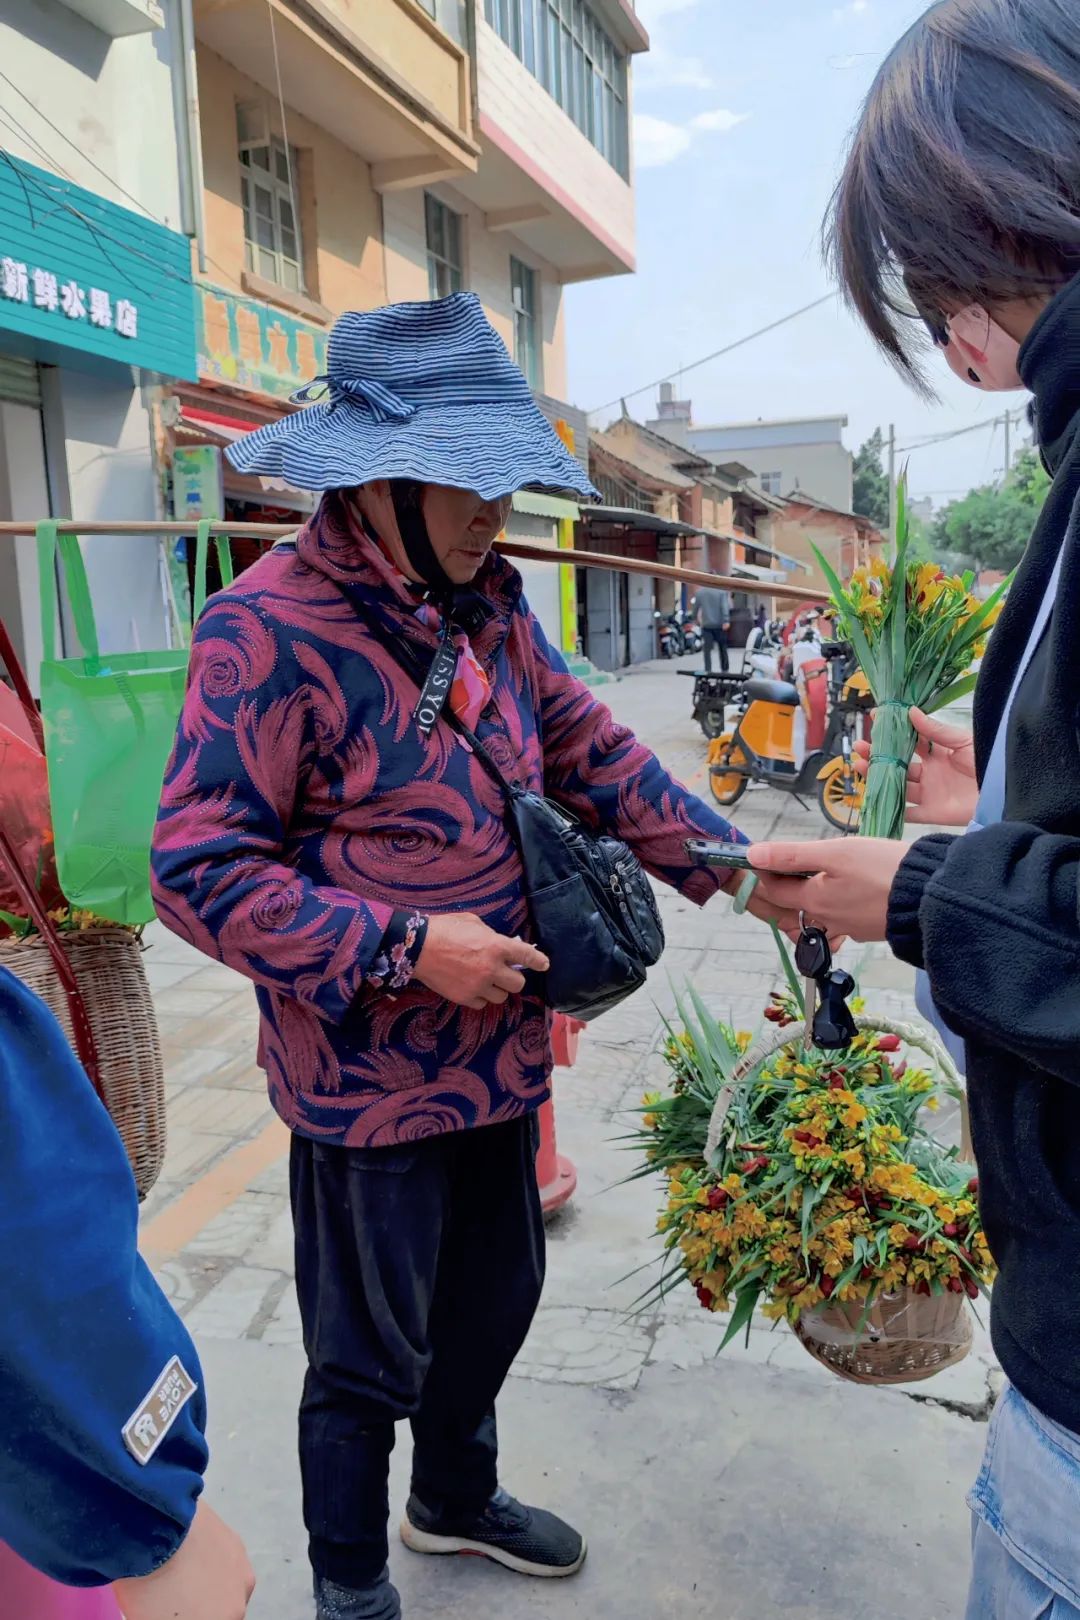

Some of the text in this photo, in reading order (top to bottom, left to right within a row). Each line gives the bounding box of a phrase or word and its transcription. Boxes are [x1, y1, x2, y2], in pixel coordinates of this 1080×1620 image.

[1, 256, 137, 338] 新鲜水果店
[160, 1379, 186, 1422] LOVE
